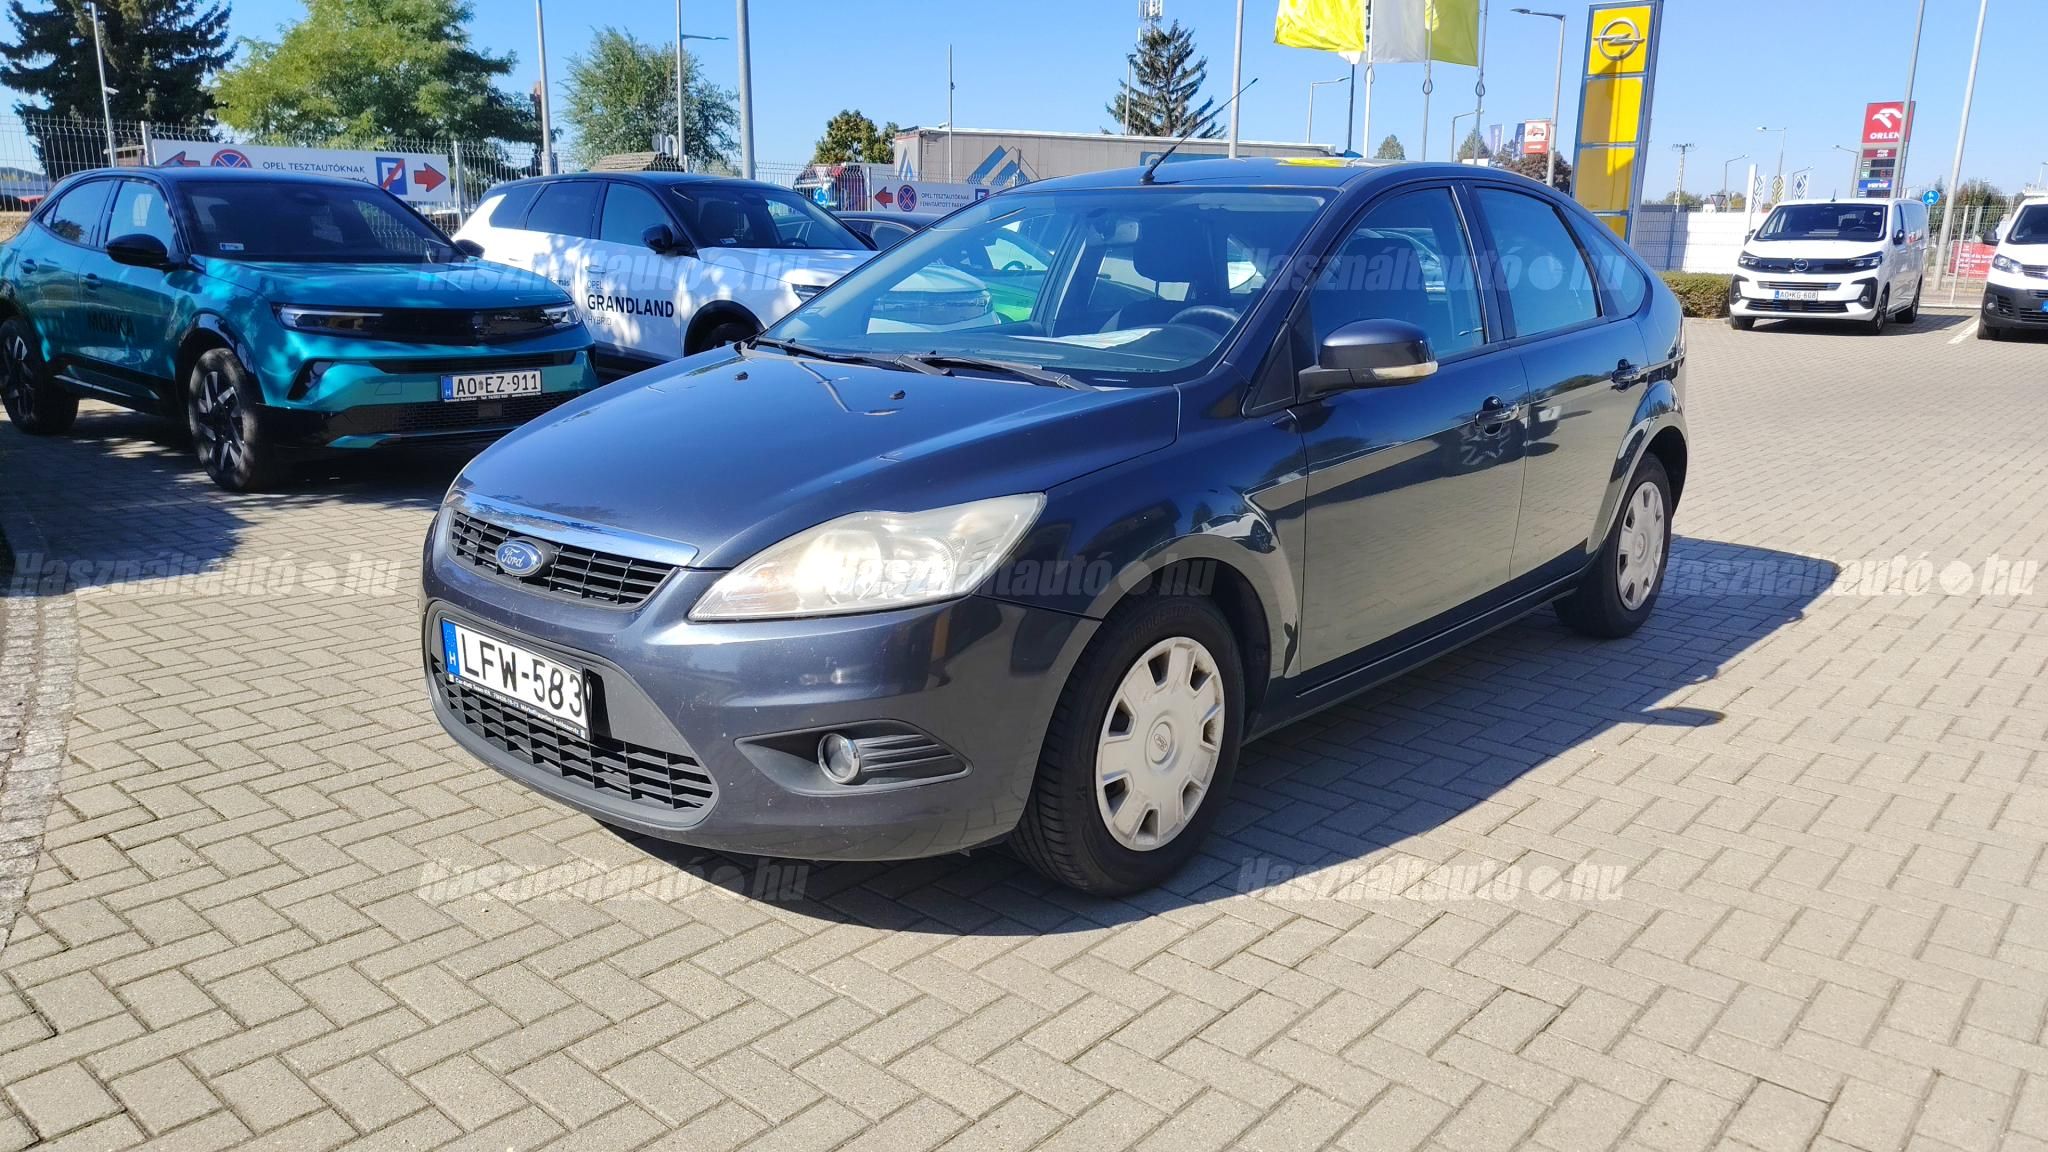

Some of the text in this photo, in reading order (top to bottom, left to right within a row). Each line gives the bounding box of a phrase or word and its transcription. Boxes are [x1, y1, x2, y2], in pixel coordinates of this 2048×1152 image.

[1869, 131, 1900, 140] ORLEN
[262, 161, 365, 174] OPEL TESZTAUTÓKNAK
[587, 294, 675, 318] GRANDLAND
[587, 315, 612, 326] HYBRID
[501, 546, 525, 567] Ford
[448, 650, 457, 667] H
[461, 633, 583, 718] LFW-583
